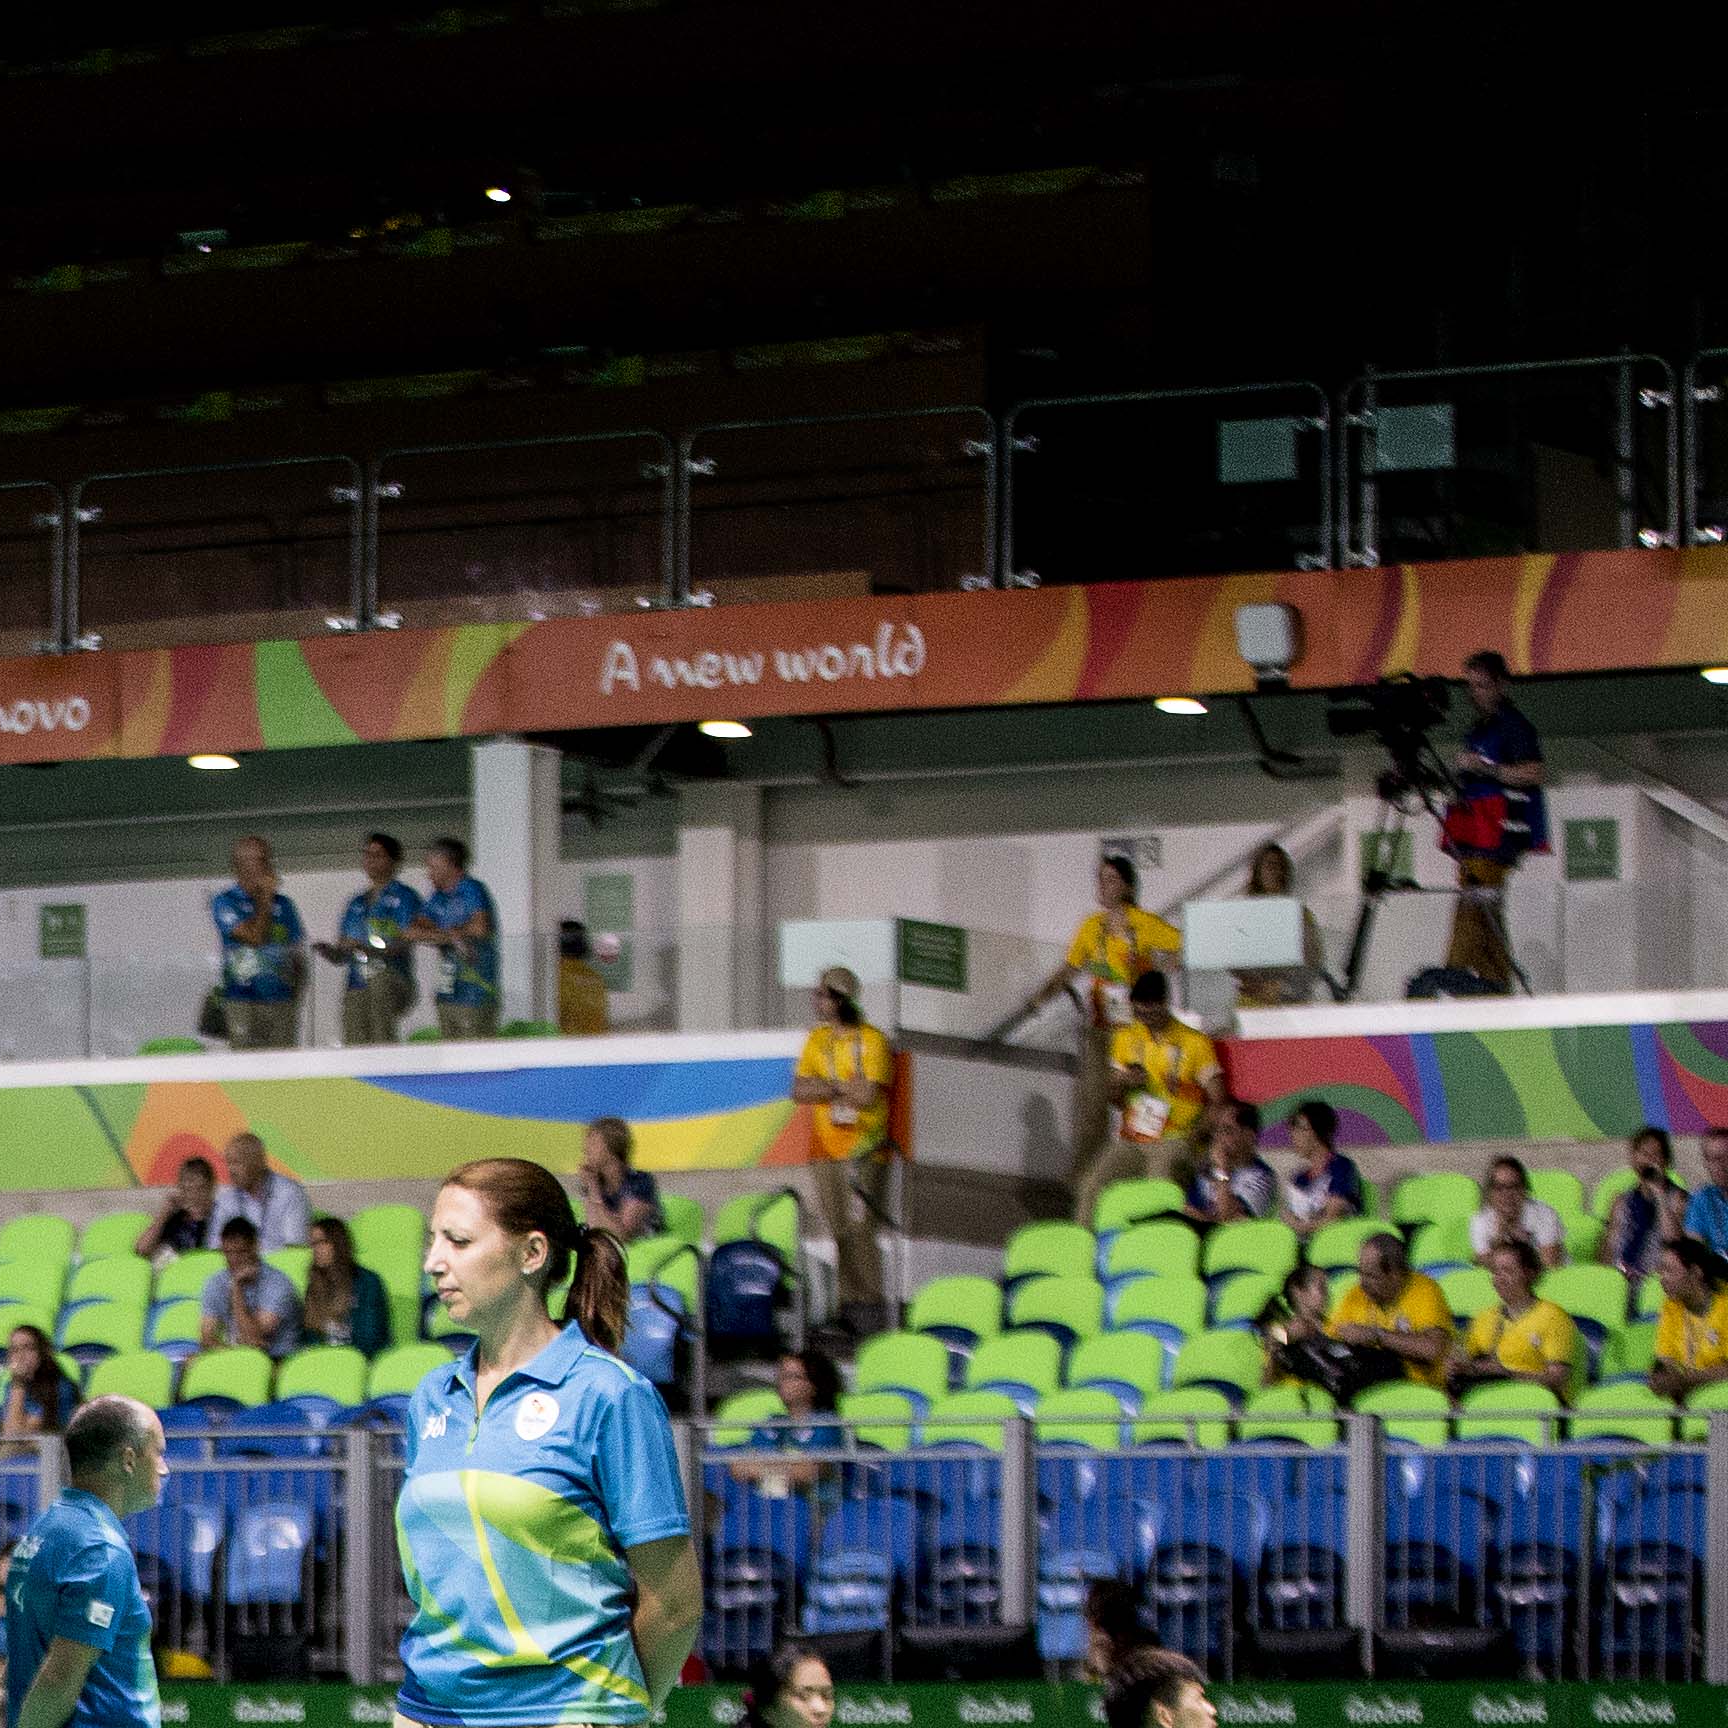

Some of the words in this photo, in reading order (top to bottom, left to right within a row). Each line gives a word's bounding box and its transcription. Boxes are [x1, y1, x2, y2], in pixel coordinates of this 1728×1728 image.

[600, 640, 642, 697] A
[646, 651, 765, 691] new
[772, 619, 928, 681] world
